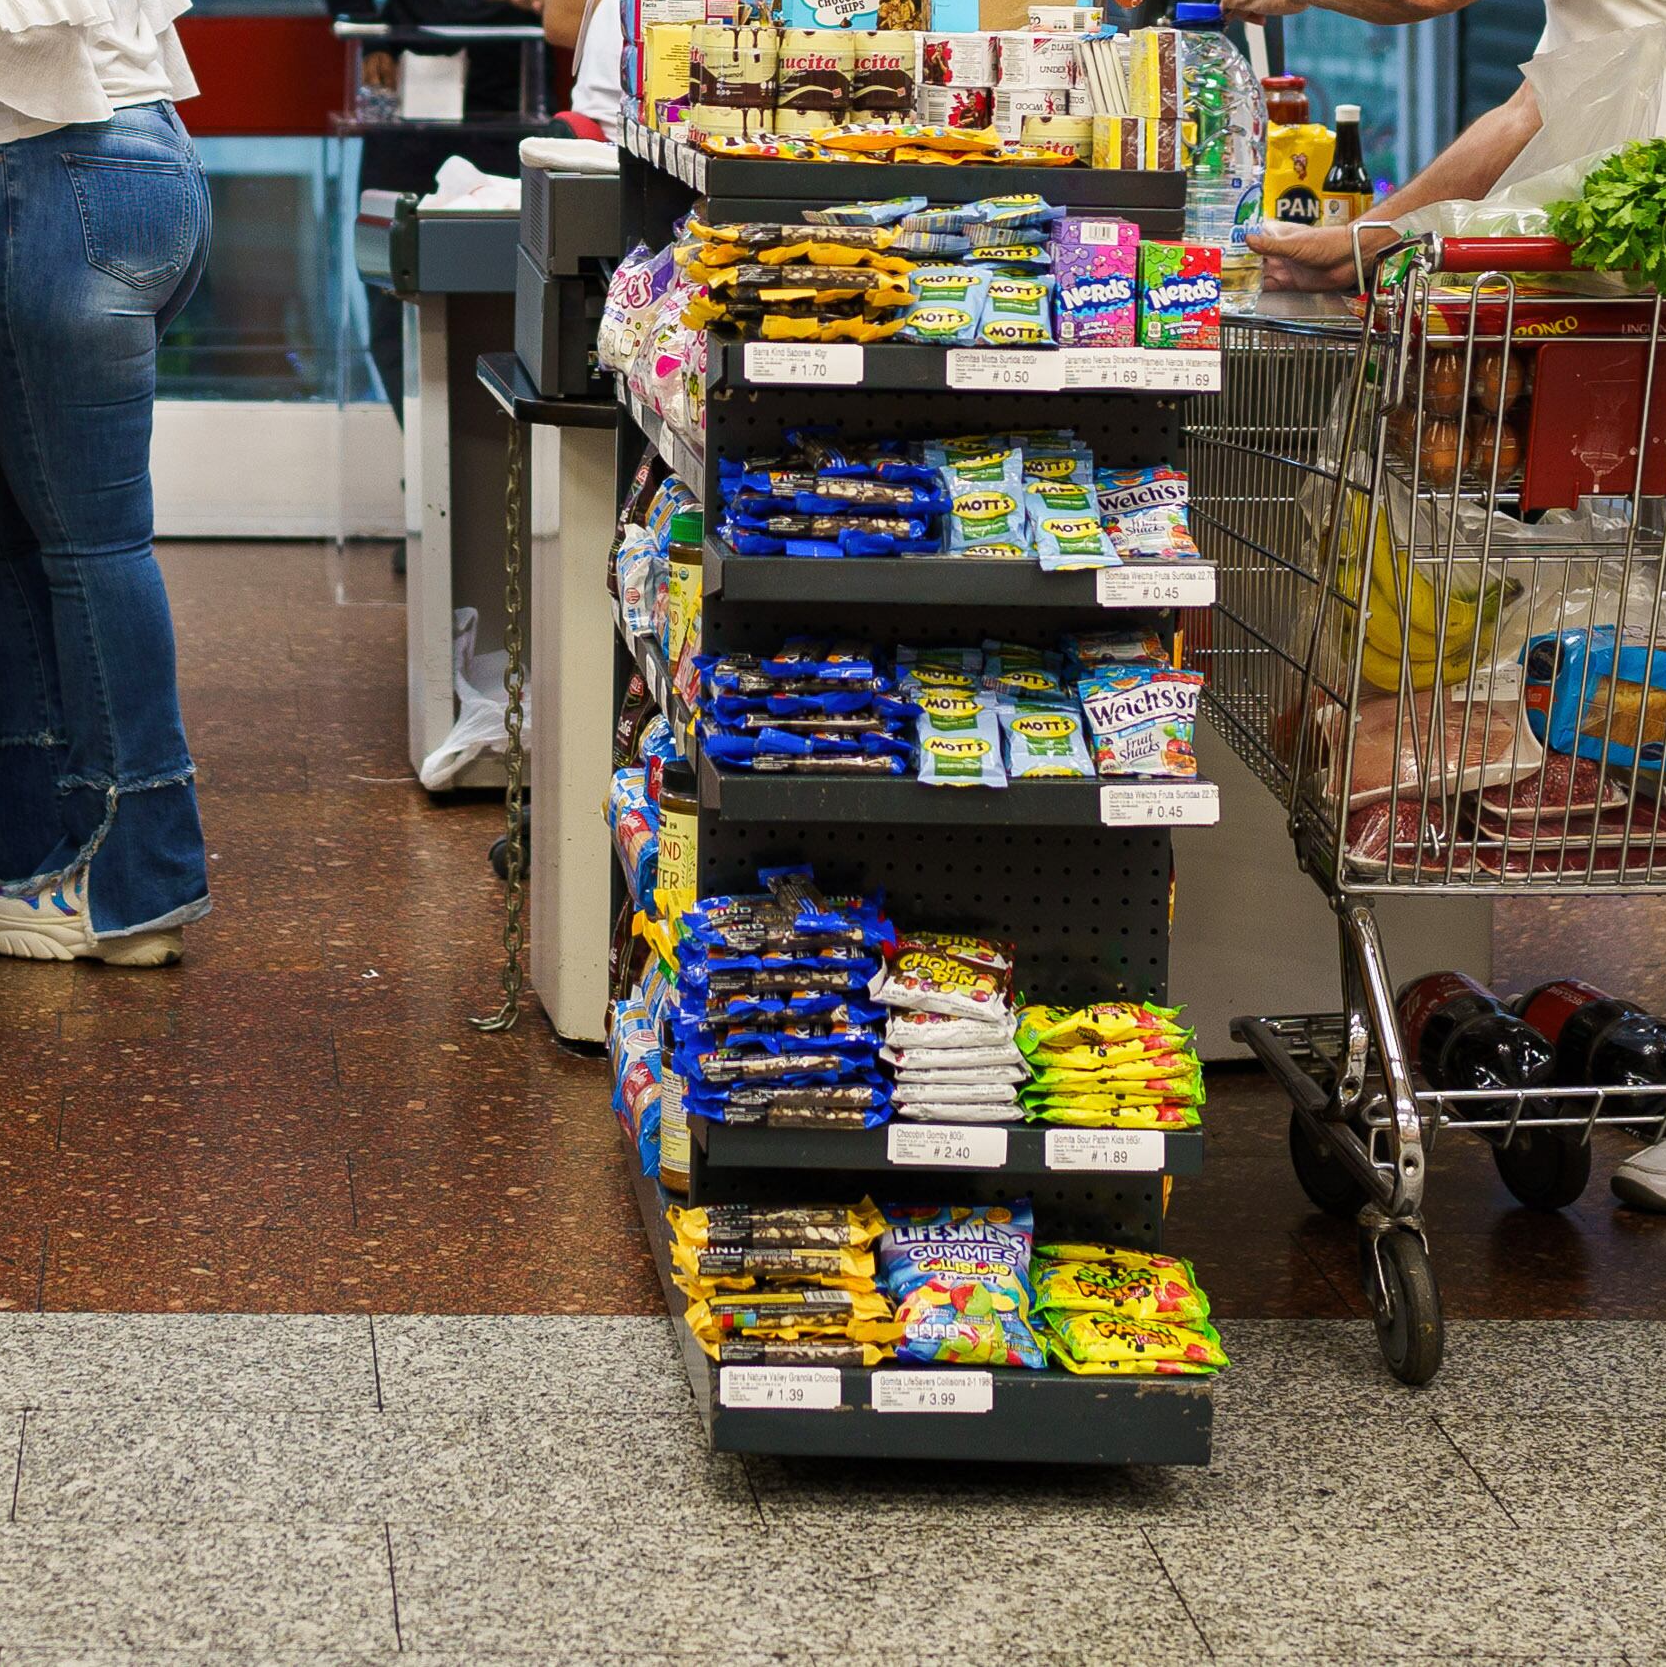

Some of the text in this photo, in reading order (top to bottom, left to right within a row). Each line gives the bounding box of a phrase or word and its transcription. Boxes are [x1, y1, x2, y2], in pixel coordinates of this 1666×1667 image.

[834, 0, 866, 16] CHIPS
[1276, 197, 1320, 219] PAN
[802, 364, 827, 377] 1.70
[1112, 370, 1138, 383] 1.69
[1003, 371, 1029, 384] 0.50
[1185, 374, 1210, 387] 1.69
[1098, 484, 1177, 512] Welch's
[1126, 523, 1165, 536] Snacks
[1153, 586, 1179, 599] 0.45
[1090, 689, 1173, 727] Welch's
[1125, 732, 1154, 750] Fruit
[1118, 742, 1161, 762] Snacks
[1157, 805, 1183, 818] 0.45
[932, 970, 978, 986] BIN
[1093, 1135, 1110, 1144] Patch
[944, 1146, 970, 1160] 2.40
[1104, 1151, 1128, 1164] 1.89
[892, 1222, 1024, 1253] LIFE SAVERS
[908, 1243, 1017, 1265] GUMMIES
[917, 1258, 1011, 1276] COLLISIONS
[779, 1389, 804, 1402] 1.39
[929, 1393, 956, 1406] 3.99
